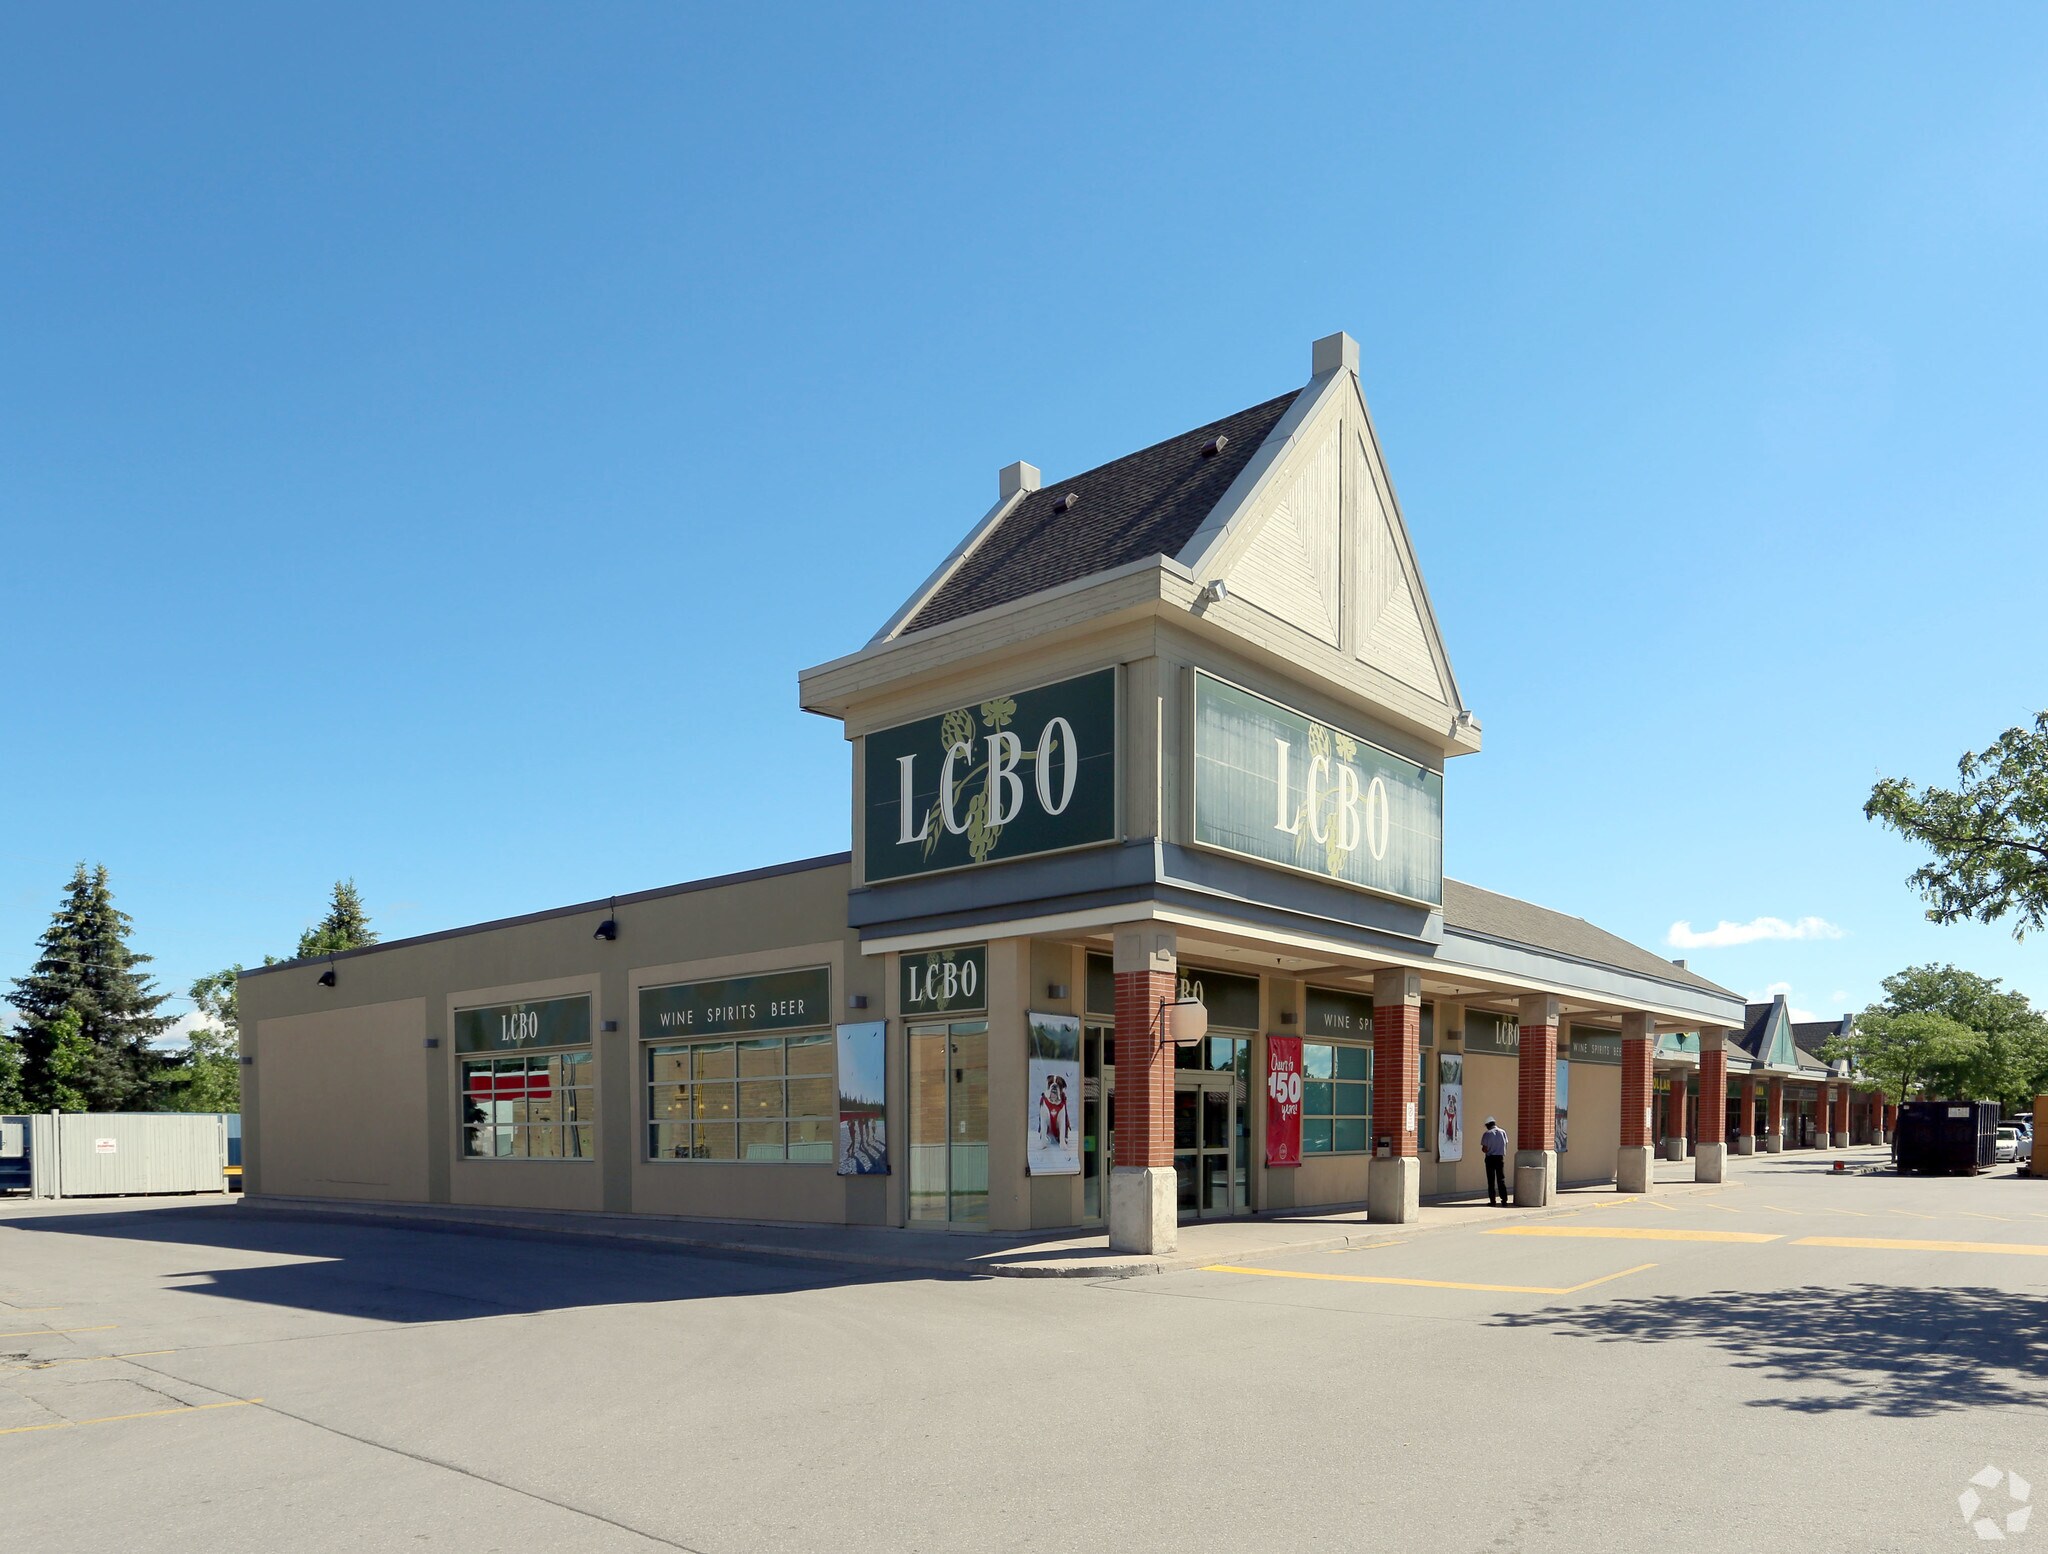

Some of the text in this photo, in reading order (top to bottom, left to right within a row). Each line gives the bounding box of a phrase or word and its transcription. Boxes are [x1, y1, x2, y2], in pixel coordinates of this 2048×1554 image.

[895, 716, 1078, 845] LCBO
[1273, 737, 1390, 861] LCBO
[908, 959, 977, 1002] LCBO
[501, 1011, 538, 1041] LCBO
[660, 999, 805, 1027] WINE SPIRITS BEER
[1323, 1013, 1350, 1029] WINE
[1496, 1020, 1520, 1046] LCBO
[1573, 1041, 1588, 1054] WINE
[1613, 1046, 1622, 1057] BEE
[1268, 1072, 1301, 1104] 150
